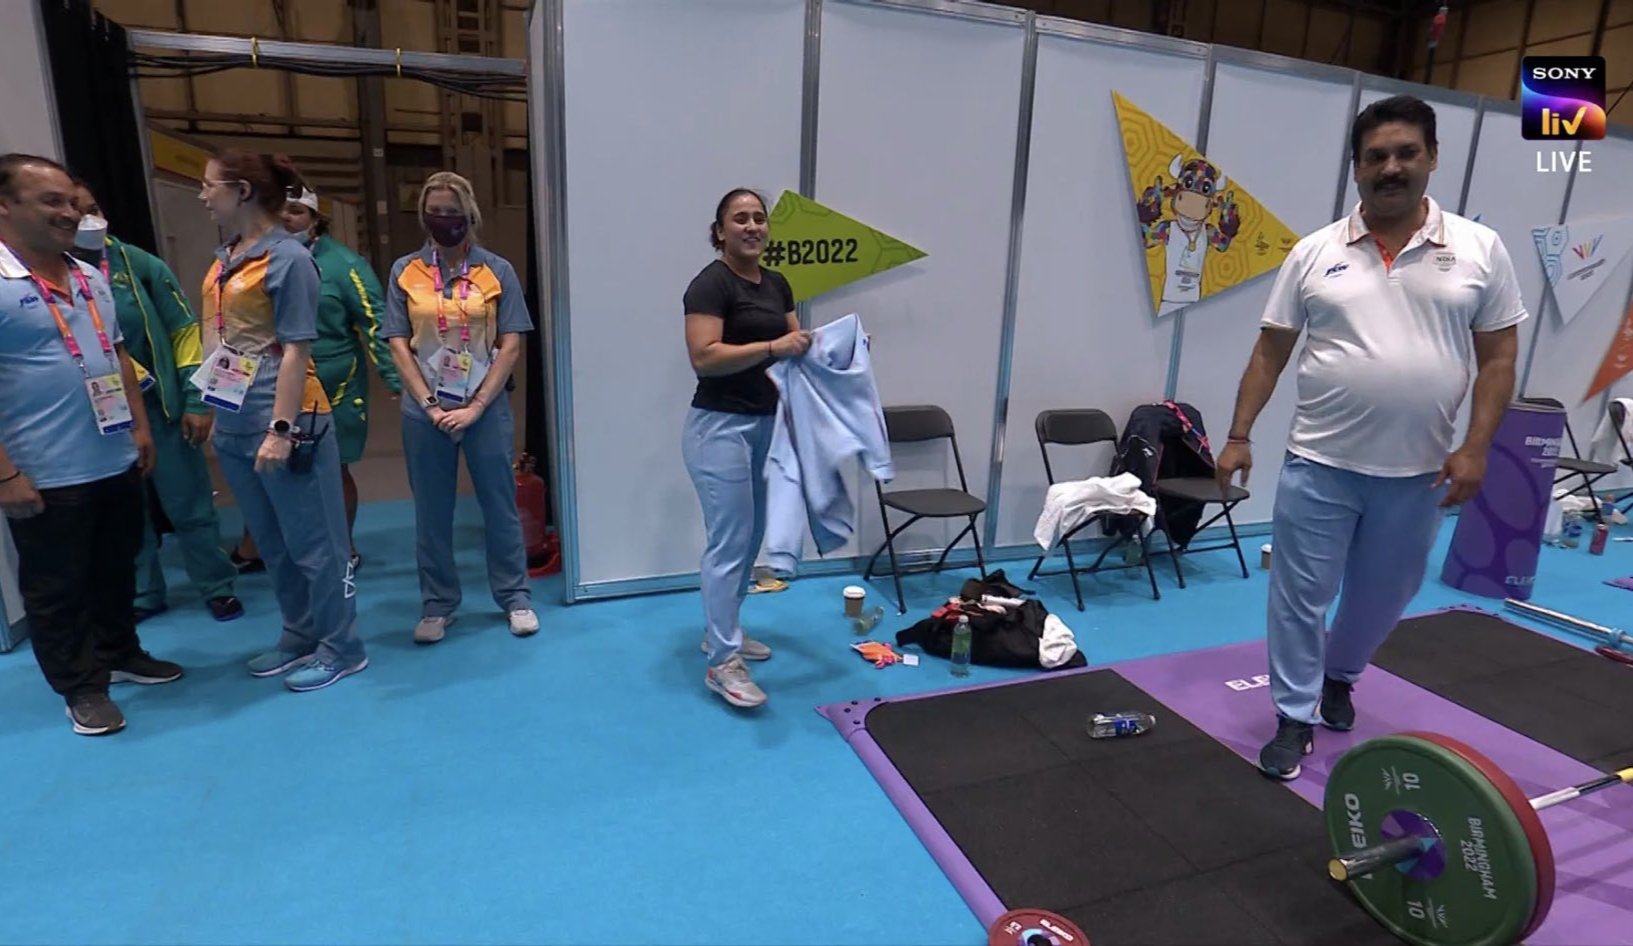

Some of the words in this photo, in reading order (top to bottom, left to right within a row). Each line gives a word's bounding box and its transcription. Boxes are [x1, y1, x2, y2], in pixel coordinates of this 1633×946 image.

[762, 238, 858, 267] #B2022
[1402, 772, 1421, 791] 10
[1460, 839, 1478, 873] 2022
[1468, 817, 1497, 900] BIRMINGHAM
[1407, 900, 1426, 920] 10
